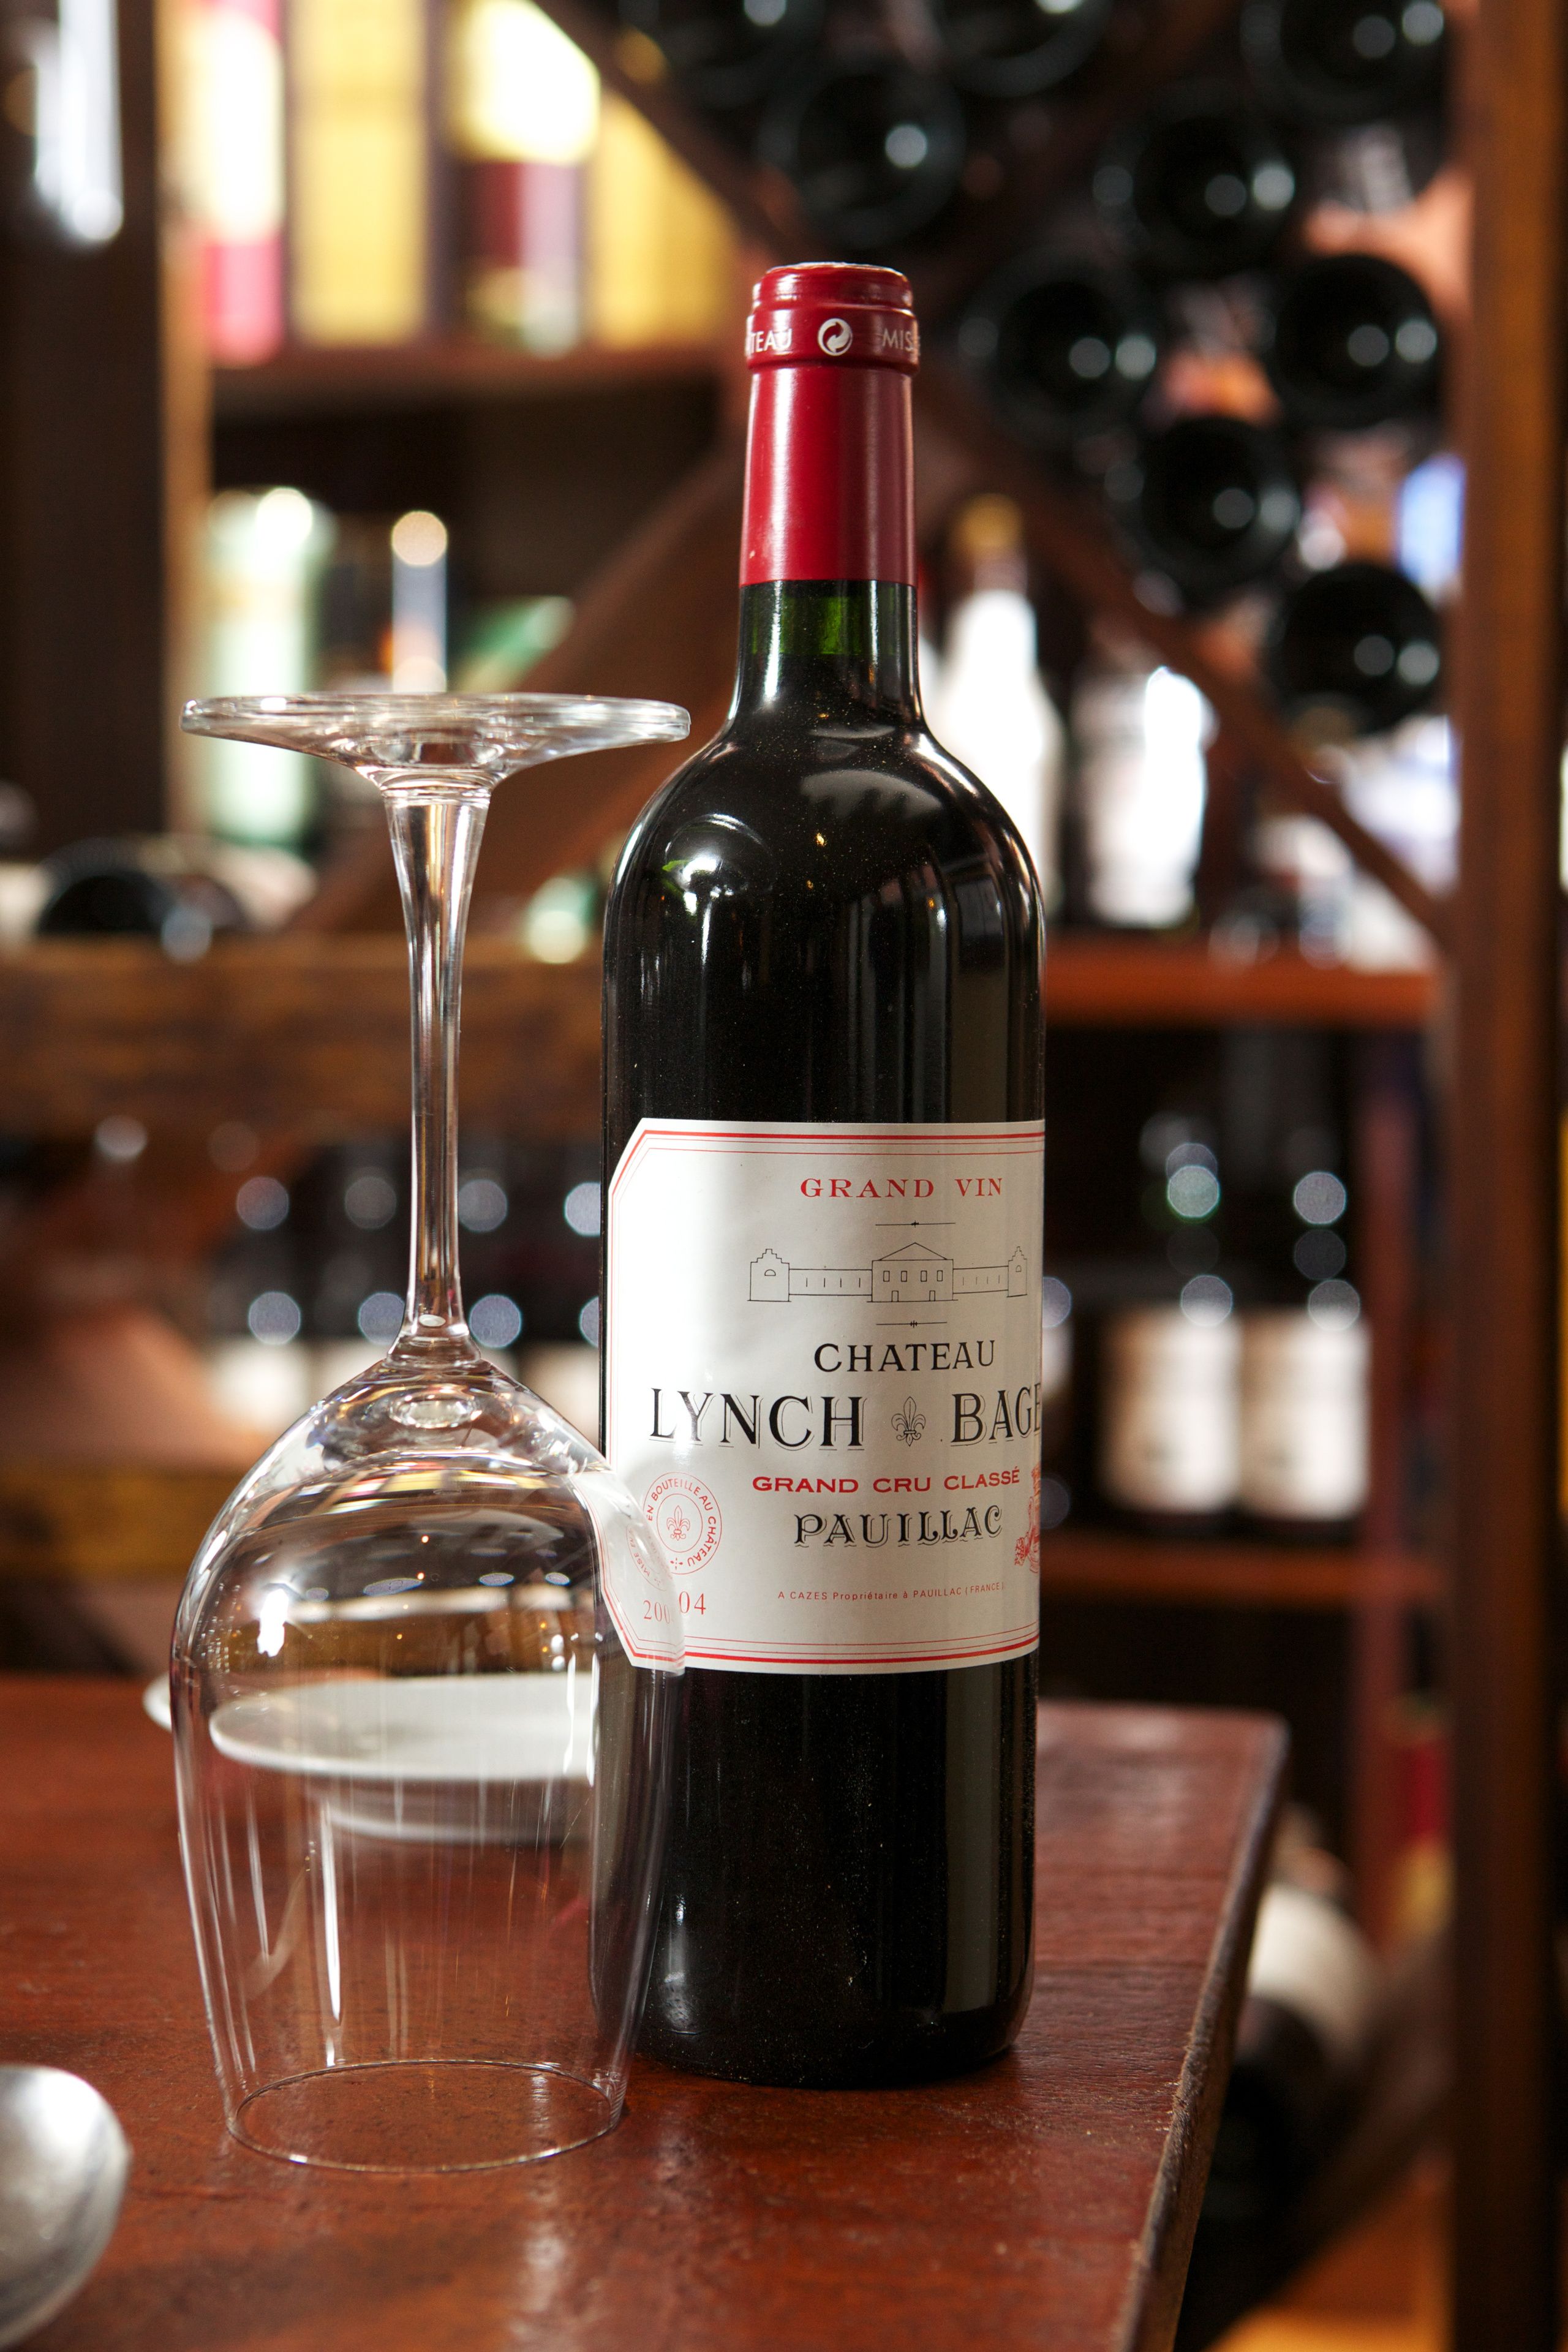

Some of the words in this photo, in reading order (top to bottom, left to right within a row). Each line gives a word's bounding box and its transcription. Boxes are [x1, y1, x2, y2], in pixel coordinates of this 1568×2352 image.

[748, 328, 793, 353] TEAU
[882, 328, 920, 356] MIS
[800, 1178, 935, 1199] GRAND
[956, 1177, 1003, 1197] VIN
[814, 1340, 995, 1373] CHATEAU
[649, 1387, 867, 1452] LYNCH
[651, 1478, 701, 1501] BOUTEILLE
[752, 1476, 859, 1494] GRAND
[873, 1477, 931, 1493] CRU
[944, 1466, 1020, 1491] CLASSÉ
[647, 1504, 654, 1521] EN
[699, 1495, 714, 1511] AU
[794, 1505, 1003, 1548] PAUILLAC
[687, 1516, 717, 1567] CHÂTEAU
[790, 1591, 827, 1600] CAZES
[832, 1591, 898, 1602] Propriétaire
[903, 1591, 908, 1599] à
[913, 1587, 962, 1598] PAUILLAC
